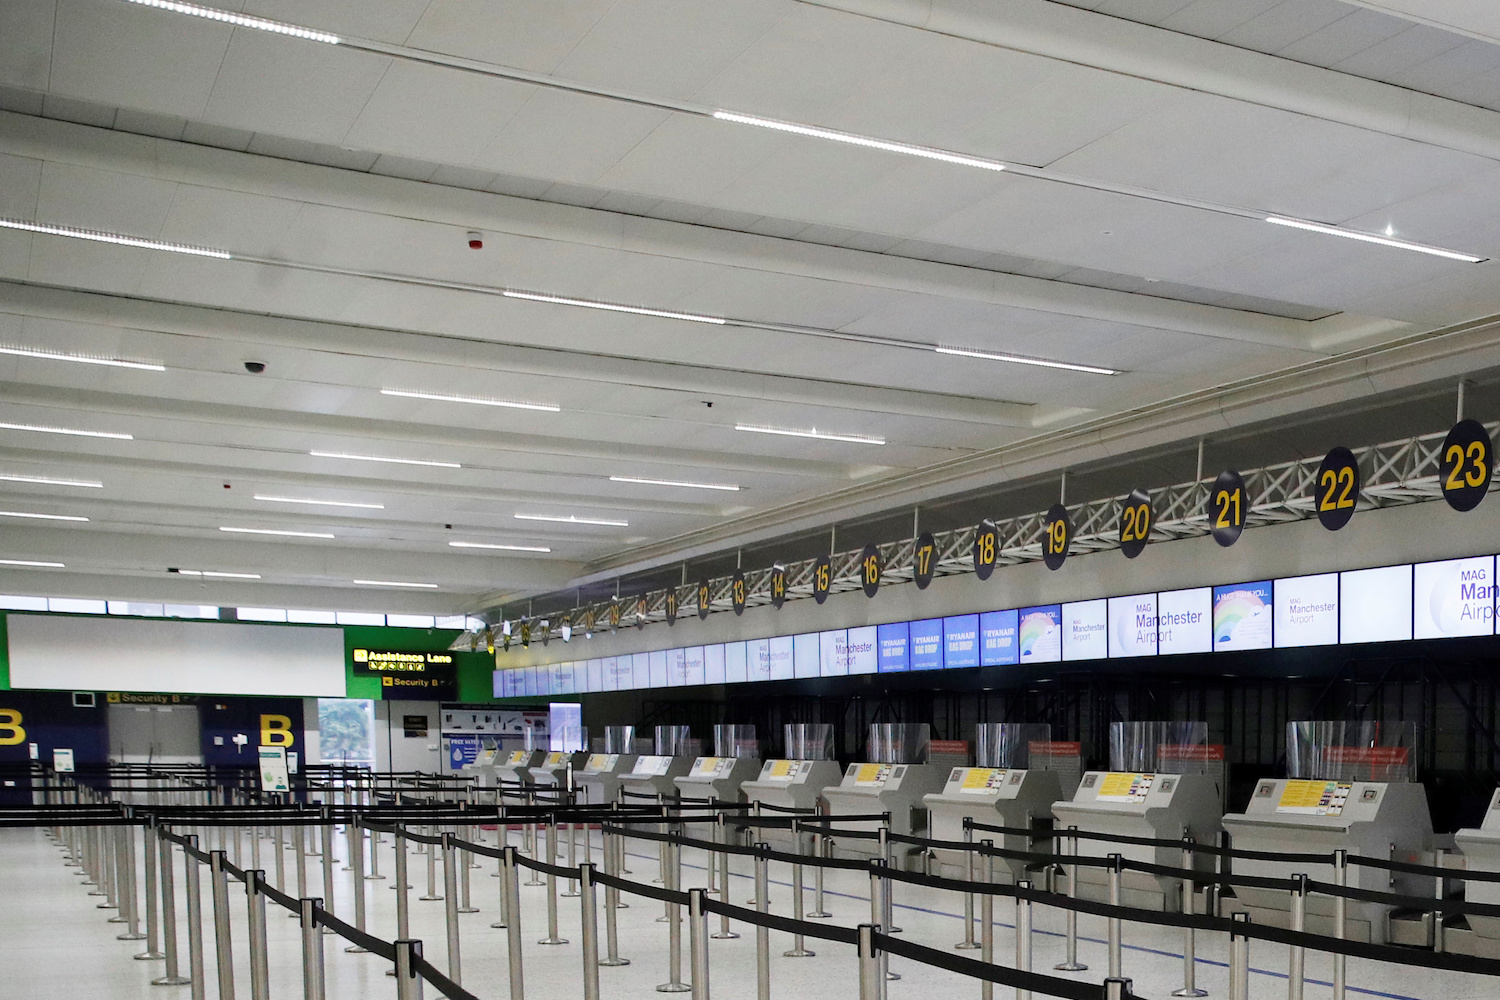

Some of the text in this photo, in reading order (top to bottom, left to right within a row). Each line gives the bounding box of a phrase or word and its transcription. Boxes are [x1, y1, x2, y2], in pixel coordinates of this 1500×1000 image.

[1445, 440, 1487, 491] 23
[1320, 466, 1354, 512] 22
[1215, 487, 1241, 529] 21
[1121, 503, 1150, 542] 20
[1046, 519, 1066, 554] 19
[977, 532, 995, 565] 18
[864, 555, 878, 584] 16
[918, 544, 932, 575] 17
[773, 573, 784, 597] 14
[816, 564, 829, 591] 15
[1461, 569, 1486, 582] MAG
[699, 586, 708, 609] 12
[733, 580, 744, 604] 13
[668, 594, 675, 615] 11
[1136, 604, 1151, 612] MAG
[1289, 602, 1336, 616] Manchester
[611, 605, 619, 625] 09
[1136, 611, 1202, 628] Manchester
[1289, 613, 1314, 625] Airport
[950, 632, 976, 641] RYANAIR
[987, 628, 1015, 637] RYANAIR
[1073, 624, 1105, 633] Manchester
[1073, 633, 1090, 641] Airport
[1136, 630, 1172, 646] Airport
[368, 651, 452, 663] Assistance Lane
[836, 643, 872, 654] Manchester
[836, 656, 856, 667] Airport
[394, 678, 429, 687] Security
[122, 693, 180, 703] Security B
[0, 708, 26, 745] B
[260, 713, 294, 748] B
